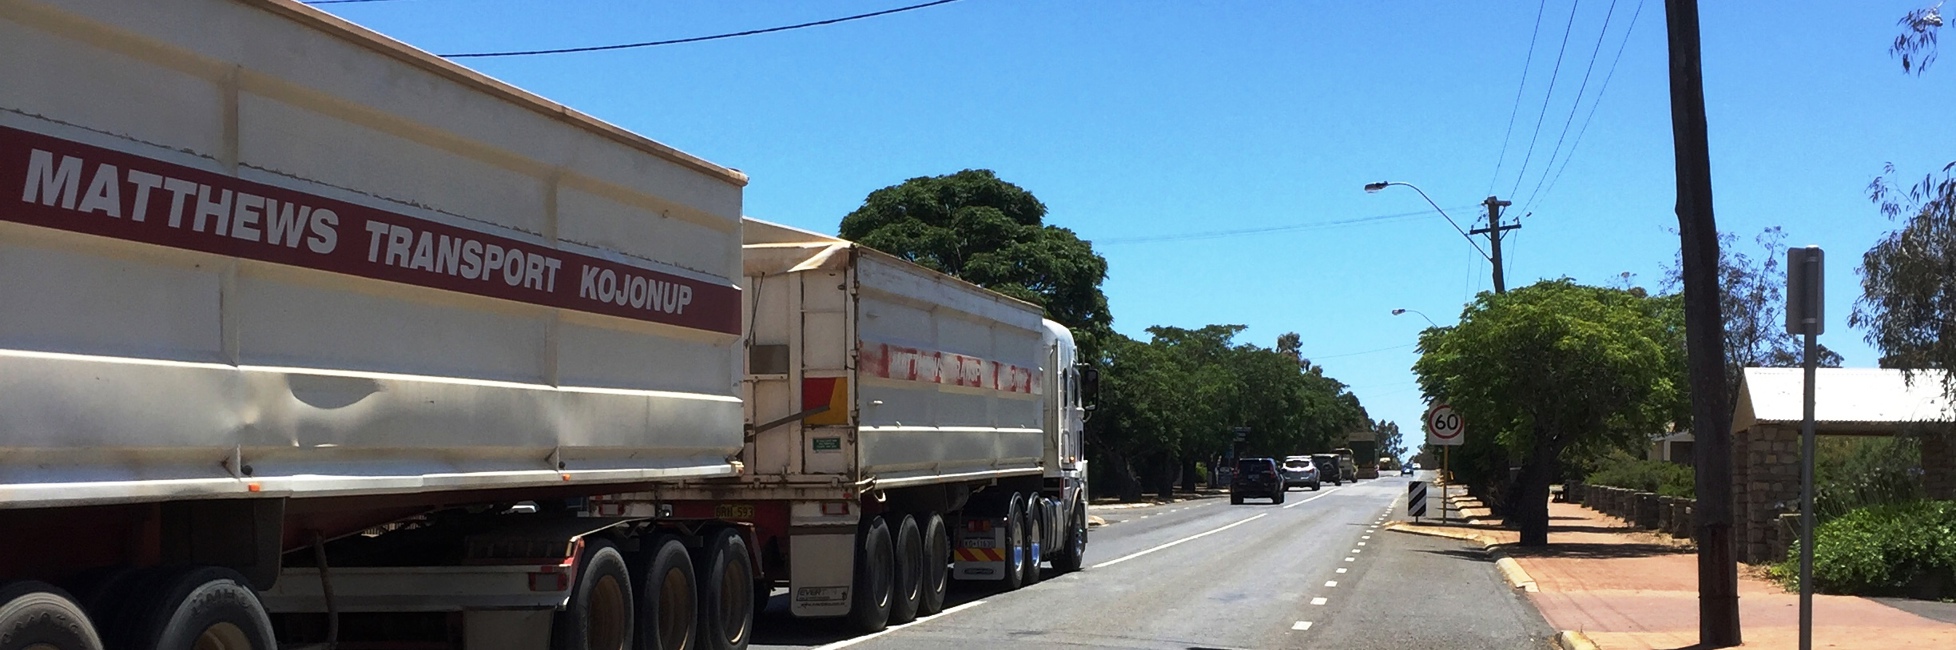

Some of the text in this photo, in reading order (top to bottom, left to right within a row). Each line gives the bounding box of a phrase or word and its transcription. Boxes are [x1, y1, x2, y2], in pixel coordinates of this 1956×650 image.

[22, 148, 694, 315] MATTHEWS TRANSPORT KOJONUP
[1435, 414, 1459, 430] 60
